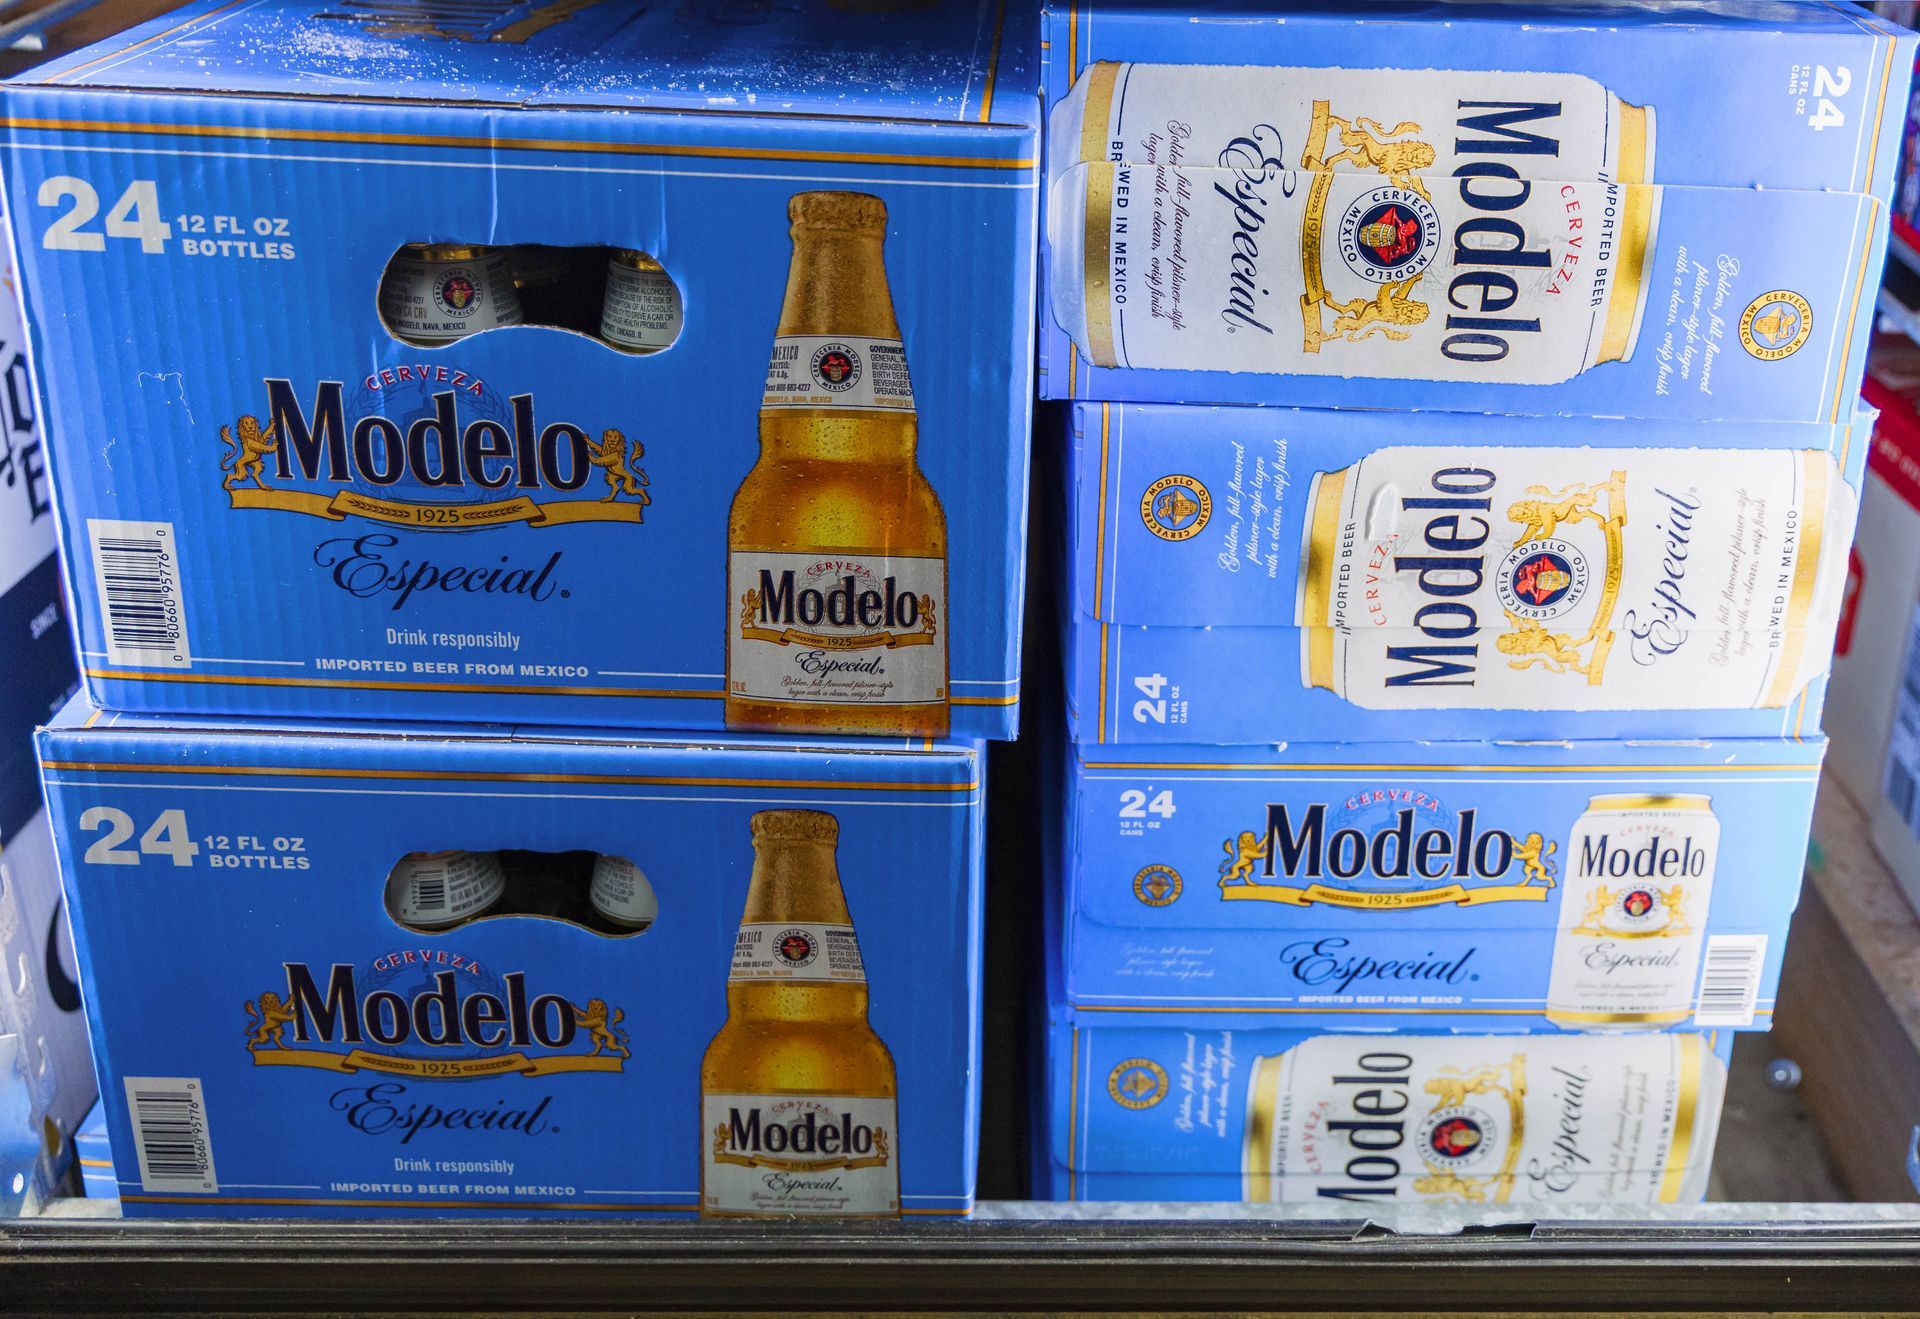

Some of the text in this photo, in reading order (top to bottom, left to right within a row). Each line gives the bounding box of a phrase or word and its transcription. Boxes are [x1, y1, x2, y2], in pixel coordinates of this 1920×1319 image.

[1788, 64, 1799, 96] CANS
[1796, 64, 1811, 115] 12 FL OZ
[1808, 65, 1852, 132] 24
[1155, 164, 1169, 195] with
[38, 176, 172, 254] 24
[1154, 197, 1163, 210] a
[1170, 167, 1191, 262] full-flavored
[177, 214, 290, 237] 12 FL OZ
[1116, 216, 1128, 234] IN
[1151, 211, 1166, 252] clean,
[1306, 215, 1319, 250] 1925
[1340, 206, 1362, 262] MEXICO
[1364, 187, 1436, 280] CERVECERIA MODELO
[1441, 99, 1563, 362] Modelo
[1545, 184, 1584, 297] CERVEZA
[181, 238, 296, 260] BOTTLES
[1114, 242, 1127, 304] MEXICO
[1144, 257, 1163, 287] crisp
[1590, 267, 1608, 308] BEER
[446, 306, 475, 317] MEXICO
[1145, 282, 1166, 319] finish
[1165, 255, 1187, 331] pilsner-style
[1654, 245, 1689, 397] with a clean, crisp finish
[1676, 259, 1709, 380] pilsner-style lager
[1699, 253, 1741, 395] Golden, full-flavored
[1741, 304, 1757, 346] MEXICO
[1755, 291, 1810, 358] CERVECERIA MODELO
[366, 363, 484, 397] CERVEZA
[812, 345, 862, 379] CERVECERIA MODELO
[821, 381, 852, 391] MEXICO
[263, 377, 592, 492] Modelo
[415, 508, 460, 524] 1925
[1143, 476, 1194, 539] CERVECERIA MODELO
[1197, 489, 1211, 528] MEXICO
[1217, 440, 1245, 572] Golden, full-flavored
[1246, 455, 1270, 566] pilsner-style lager
[1265, 438, 1290, 579] with a clean, crisp finish
[1342, 521, 1356, 558] BEER
[157, 553, 174, 594] 95776
[807, 561, 871, 577] CERVEZA
[1384, 466, 1497, 689] Modelo
[1501, 541, 1567, 618] CERVECERIA MODELO
[1567, 556, 1586, 604] MEXICO
[1606, 566, 1619, 595] 1925
[1768, 510, 1797, 648] BRWED IN MEXICO
[759, 569, 919, 628] Modelo
[163, 599, 180, 639] 80660
[386, 628, 520, 651] Drink responsibly
[826, 637, 852, 646] 1925
[315, 658, 589, 679] IMPORTED BEER FROM MEXICO
[1132, 672, 1168, 724] 24
[1170, 685, 1180, 724] 12 FL OZ
[1180, 700, 1188, 724] CANS
[1119, 789, 1176, 818] 24
[1346, 788, 1439, 812] CERVEZA
[79, 806, 199, 866] 24
[204, 835, 306, 851] 12 FL OZ
[1261, 803, 1513, 880] Modelo
[1579, 834, 1705, 877] Modelo
[209, 854, 310, 870] BOTTLES
[1367, 894, 1403, 906] 1925
[374, 949, 481, 976] CERVEZA
[282, 961, 577, 1048] Modelo
[1298, 996, 1463, 1004] IMPORTED BEER FROM MEXICO
[421, 1062, 460, 1075] 1925
[189, 1102, 203, 1135] 95776
[729, 1107, 872, 1154] Modelo
[194, 1138, 208, 1171] 80660
[394, 1158, 514, 1175] Drink responsibly
[331, 1182, 576, 1196] IMPORTED BEER FROM MEXICO
